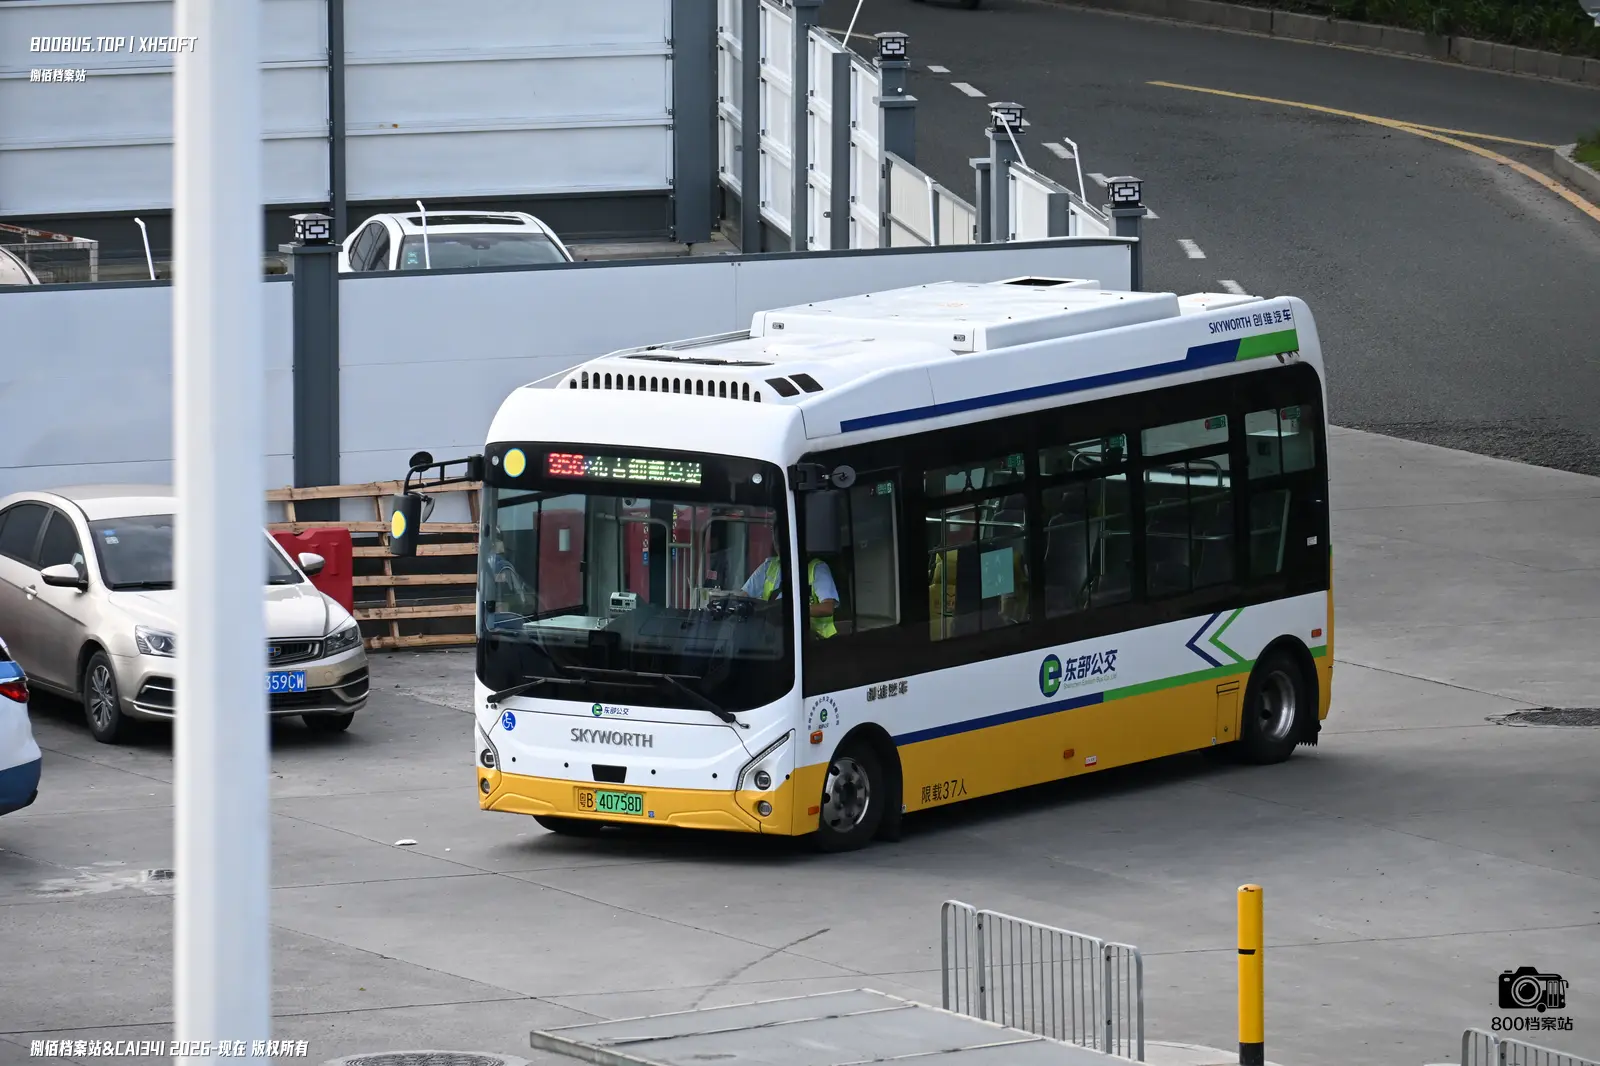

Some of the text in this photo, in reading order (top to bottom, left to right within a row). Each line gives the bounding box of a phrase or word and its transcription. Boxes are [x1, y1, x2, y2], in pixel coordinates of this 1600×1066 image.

[1208, 309, 1292, 334] SKYWORTH 创维汽车
[1064, 649, 1118, 682] 东部公交
[570, 727, 653, 748] SKYWORTH
[921, 778, 968, 804] 限载37人
